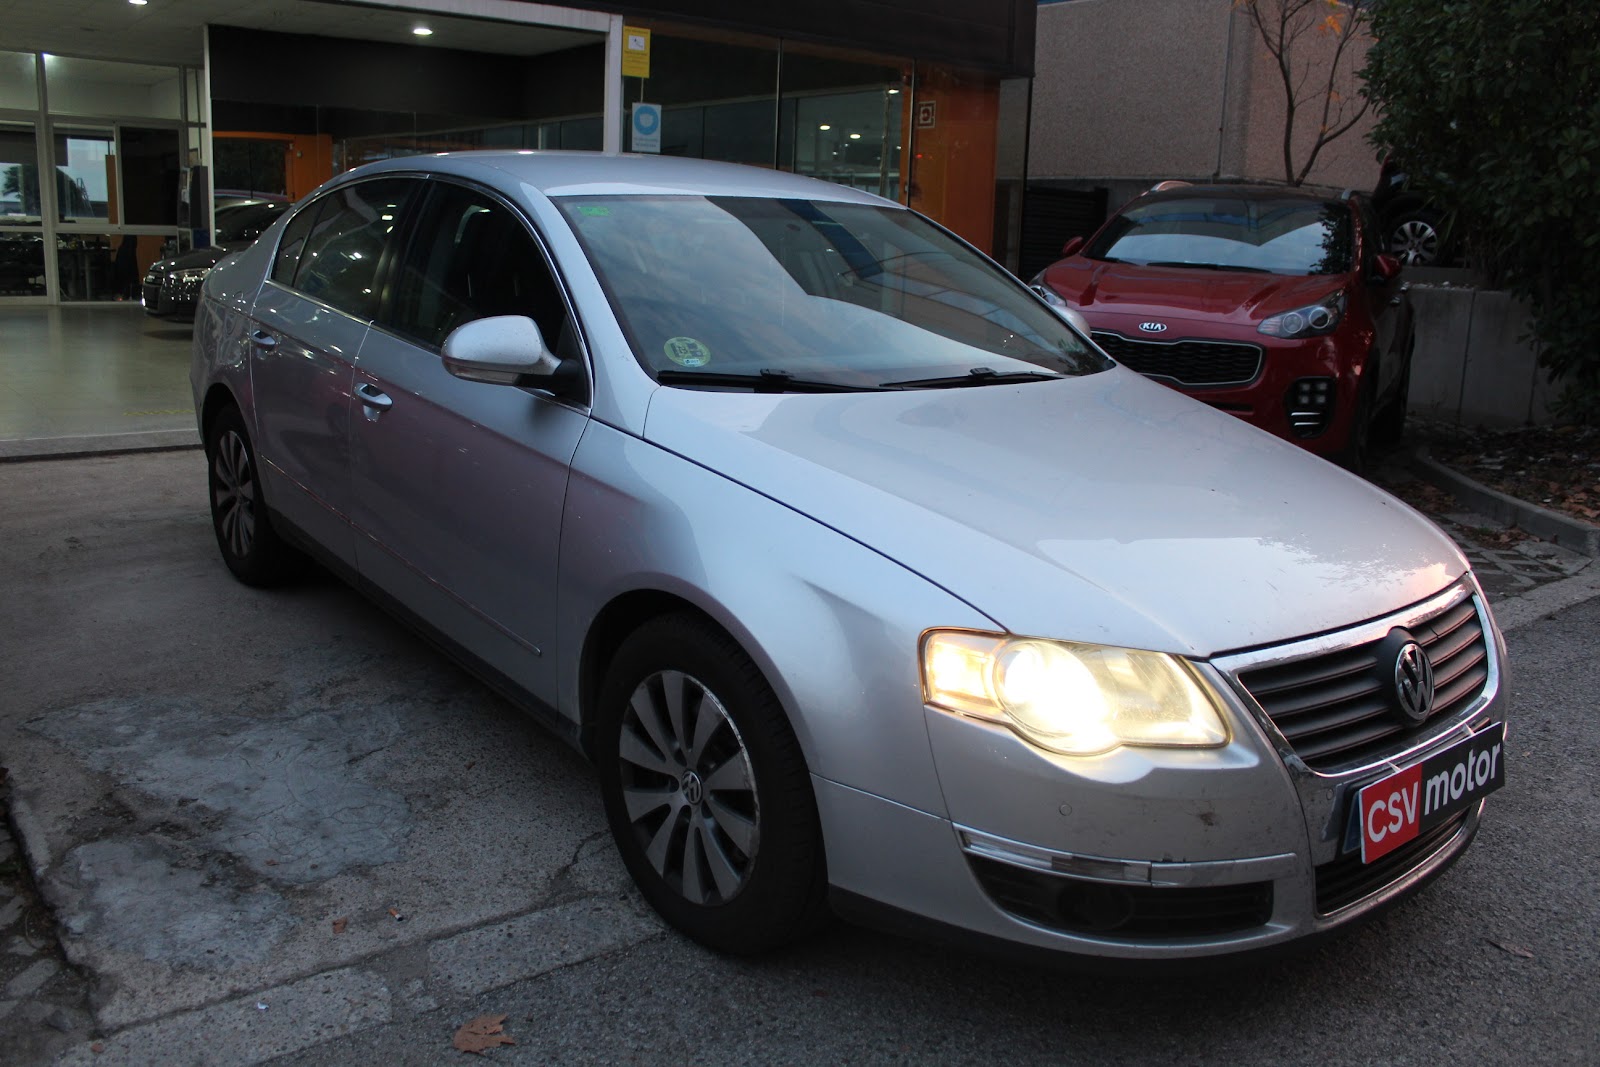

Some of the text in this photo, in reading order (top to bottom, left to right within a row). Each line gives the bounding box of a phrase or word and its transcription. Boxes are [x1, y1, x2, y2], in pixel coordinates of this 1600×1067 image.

[1142, 322, 1162, 330] KIA
[1367, 743, 1500, 843] CSV motor
